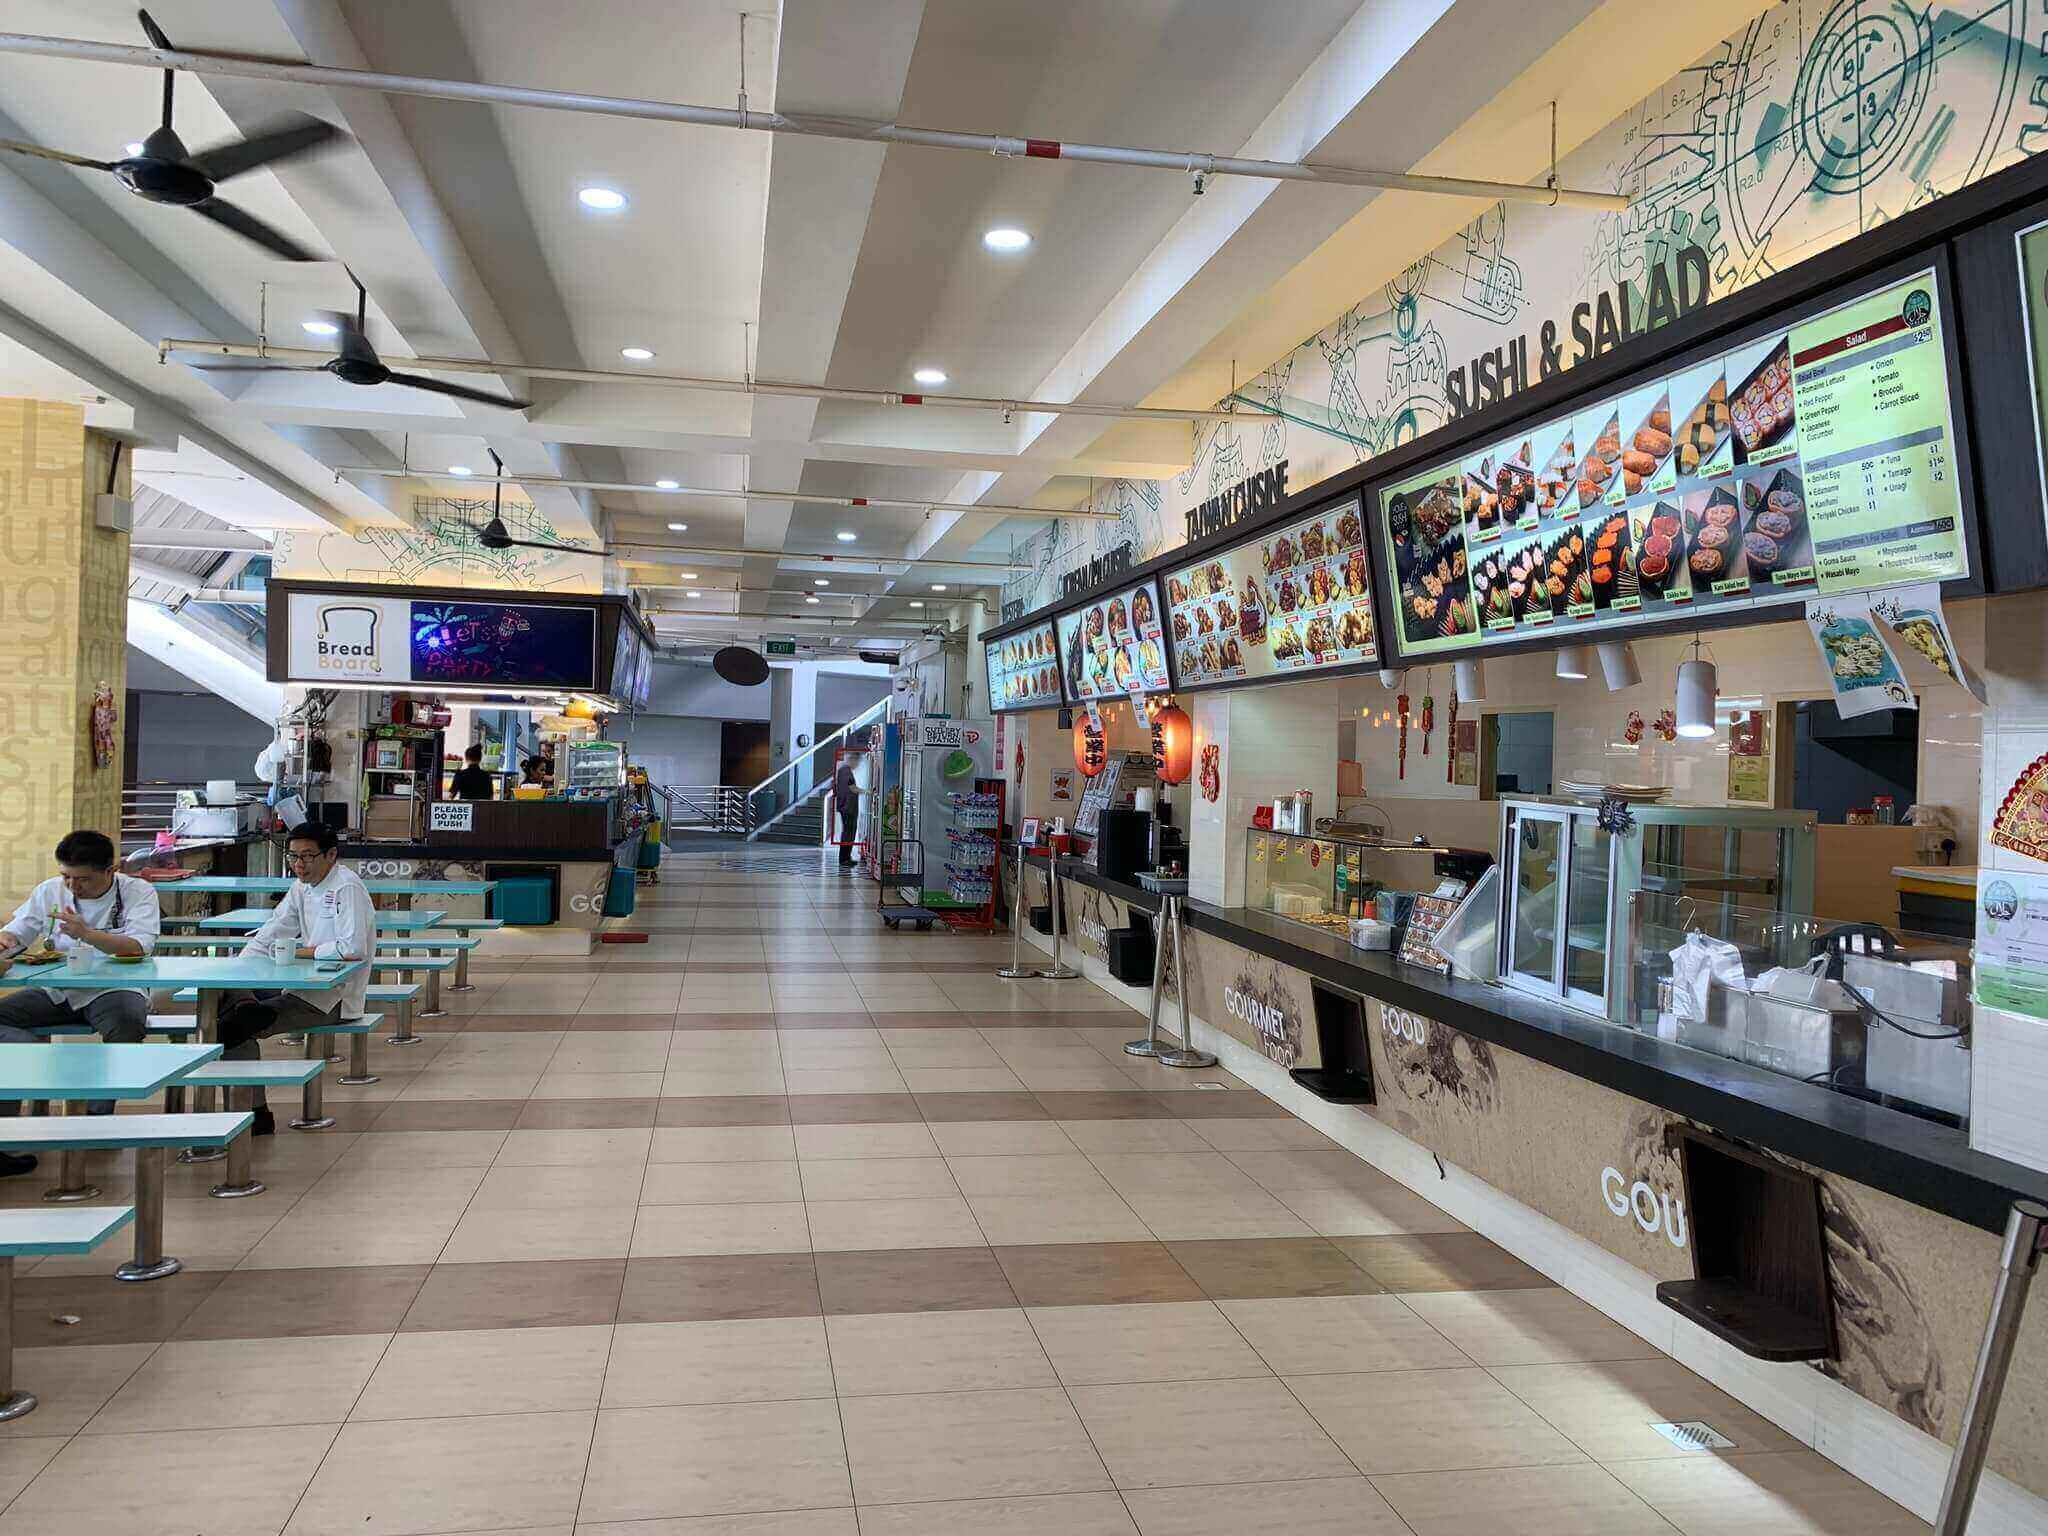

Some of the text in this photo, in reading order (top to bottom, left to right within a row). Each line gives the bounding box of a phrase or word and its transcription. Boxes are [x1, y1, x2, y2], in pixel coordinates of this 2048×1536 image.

[1446, 246, 1711, 420] SUSHI & SALAD
[1845, 332, 1867, 347] Salad
[1875, 358, 1895, 371] Onion
[1877, 371, 1900, 384] Tomato
[1801, 381, 1825, 394] Romaine
[1878, 384, 1904, 398] Broccoli
[1815, 392, 1834, 405] Pepper
[1879, 393, 1920, 411] Carrot Sliced
[1804, 403, 1840, 421] Green Pepper
[1886, 455, 1901, 465] Tuna
[1830, 471, 1841, 481] Egg
[1888, 467, 1912, 478] Tamago
[1232, 461, 1289, 521] CUISINE
[1816, 509, 1837, 521] Teriyaki
[1837, 505, 1860, 517] Chicken
[1823, 553, 1856, 566] Goma Sauce
[1825, 566, 1860, 579] Wasabi Mayo
[318, 641, 374, 656] Bread
[319, 656, 381, 671] Board
[358, 860, 412, 876] FOOD
[1224, 986, 1284, 1041] GOURMET
[1380, 1003, 1425, 1046] FOOD
[1263, 1032, 1294, 1070] FOOD
